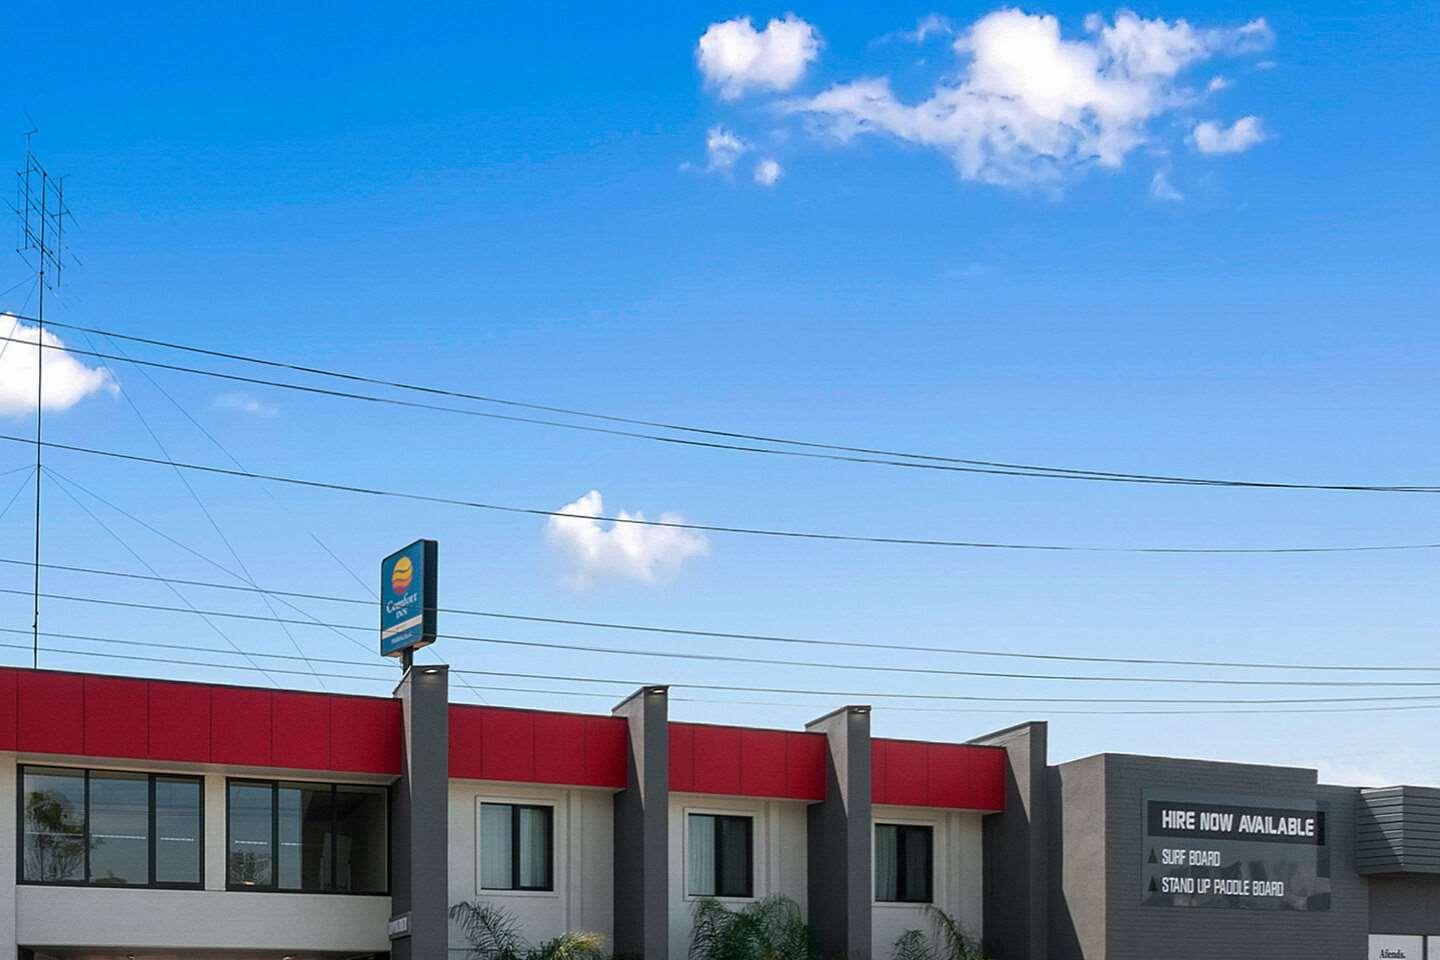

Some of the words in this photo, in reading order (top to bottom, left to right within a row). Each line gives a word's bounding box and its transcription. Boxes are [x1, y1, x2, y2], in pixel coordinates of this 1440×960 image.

[1162, 810, 1196, 830] HIRE
[1200, 812, 1234, 832] NOW
[1238, 814, 1314, 836] AVAILABLE
[1162, 848, 1186, 865] SURF
[1189, 850, 1220, 867] BOARD
[1162, 876, 1194, 894] STAND
[1197, 878, 1211, 894] UP
[1213, 879, 1250, 896] PADDLE
[1252, 880, 1284, 897] BOARD
